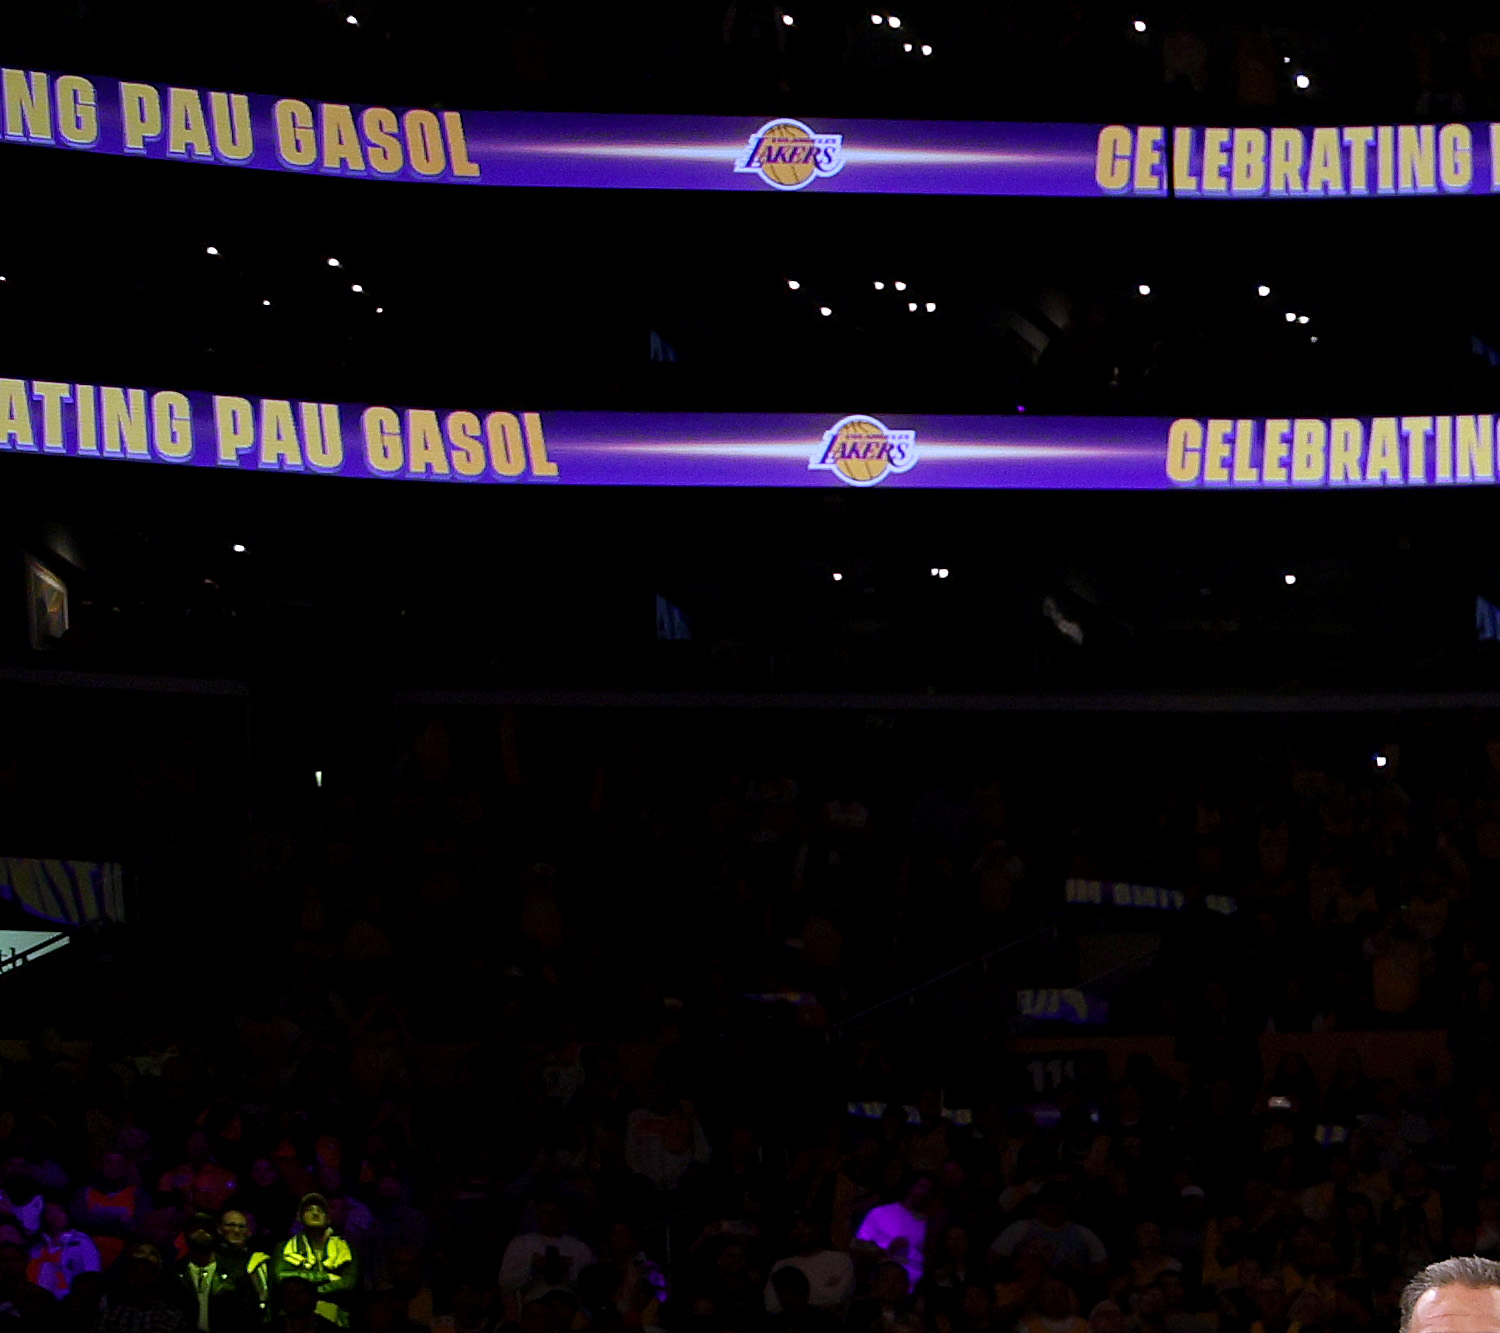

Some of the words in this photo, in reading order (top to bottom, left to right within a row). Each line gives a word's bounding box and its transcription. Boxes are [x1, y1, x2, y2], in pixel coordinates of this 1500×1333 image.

[122, 81, 254, 162] PAU
[275, 96, 481, 179] GASOL
[745, 138, 836, 171] LAKERS
[1096, 123, 1472, 192] CELEBRATING
[216, 395, 344, 470] PAU
[364, 404, 560, 478] GASOL
[820, 434, 909, 466] LAKERS
